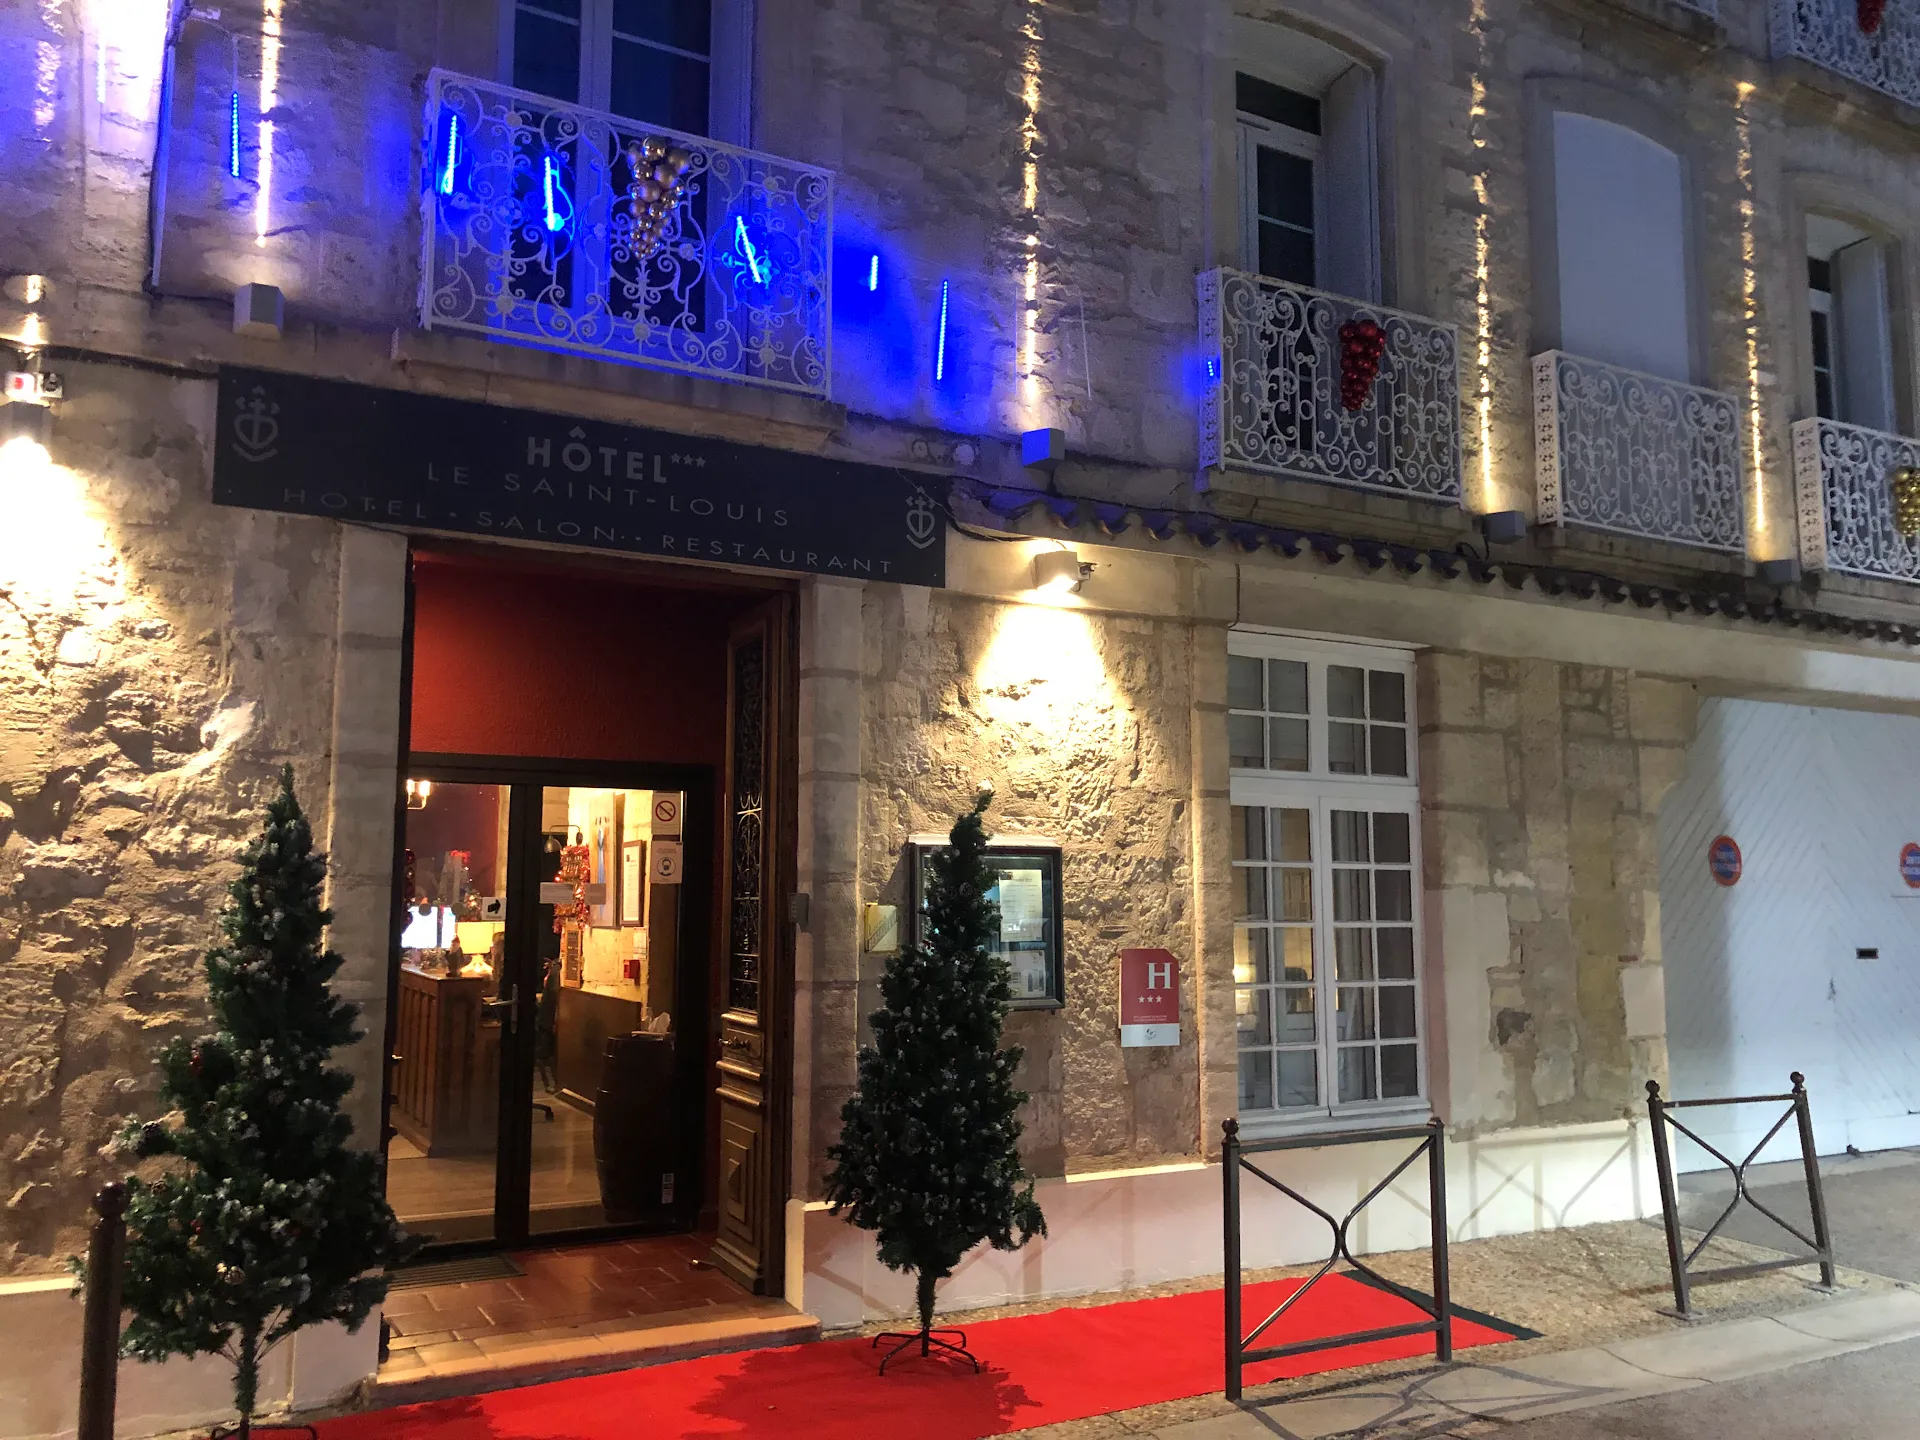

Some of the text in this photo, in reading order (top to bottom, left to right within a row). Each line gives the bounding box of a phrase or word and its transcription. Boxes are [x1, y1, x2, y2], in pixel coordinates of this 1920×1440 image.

[525, 425, 668, 484] HÔTEL
[428, 462, 789, 527] LE SAINT-LOUIS
[284, 487, 892, 574] HOTEL SALON RESTAURANT
[1146, 962, 1172, 989] H
